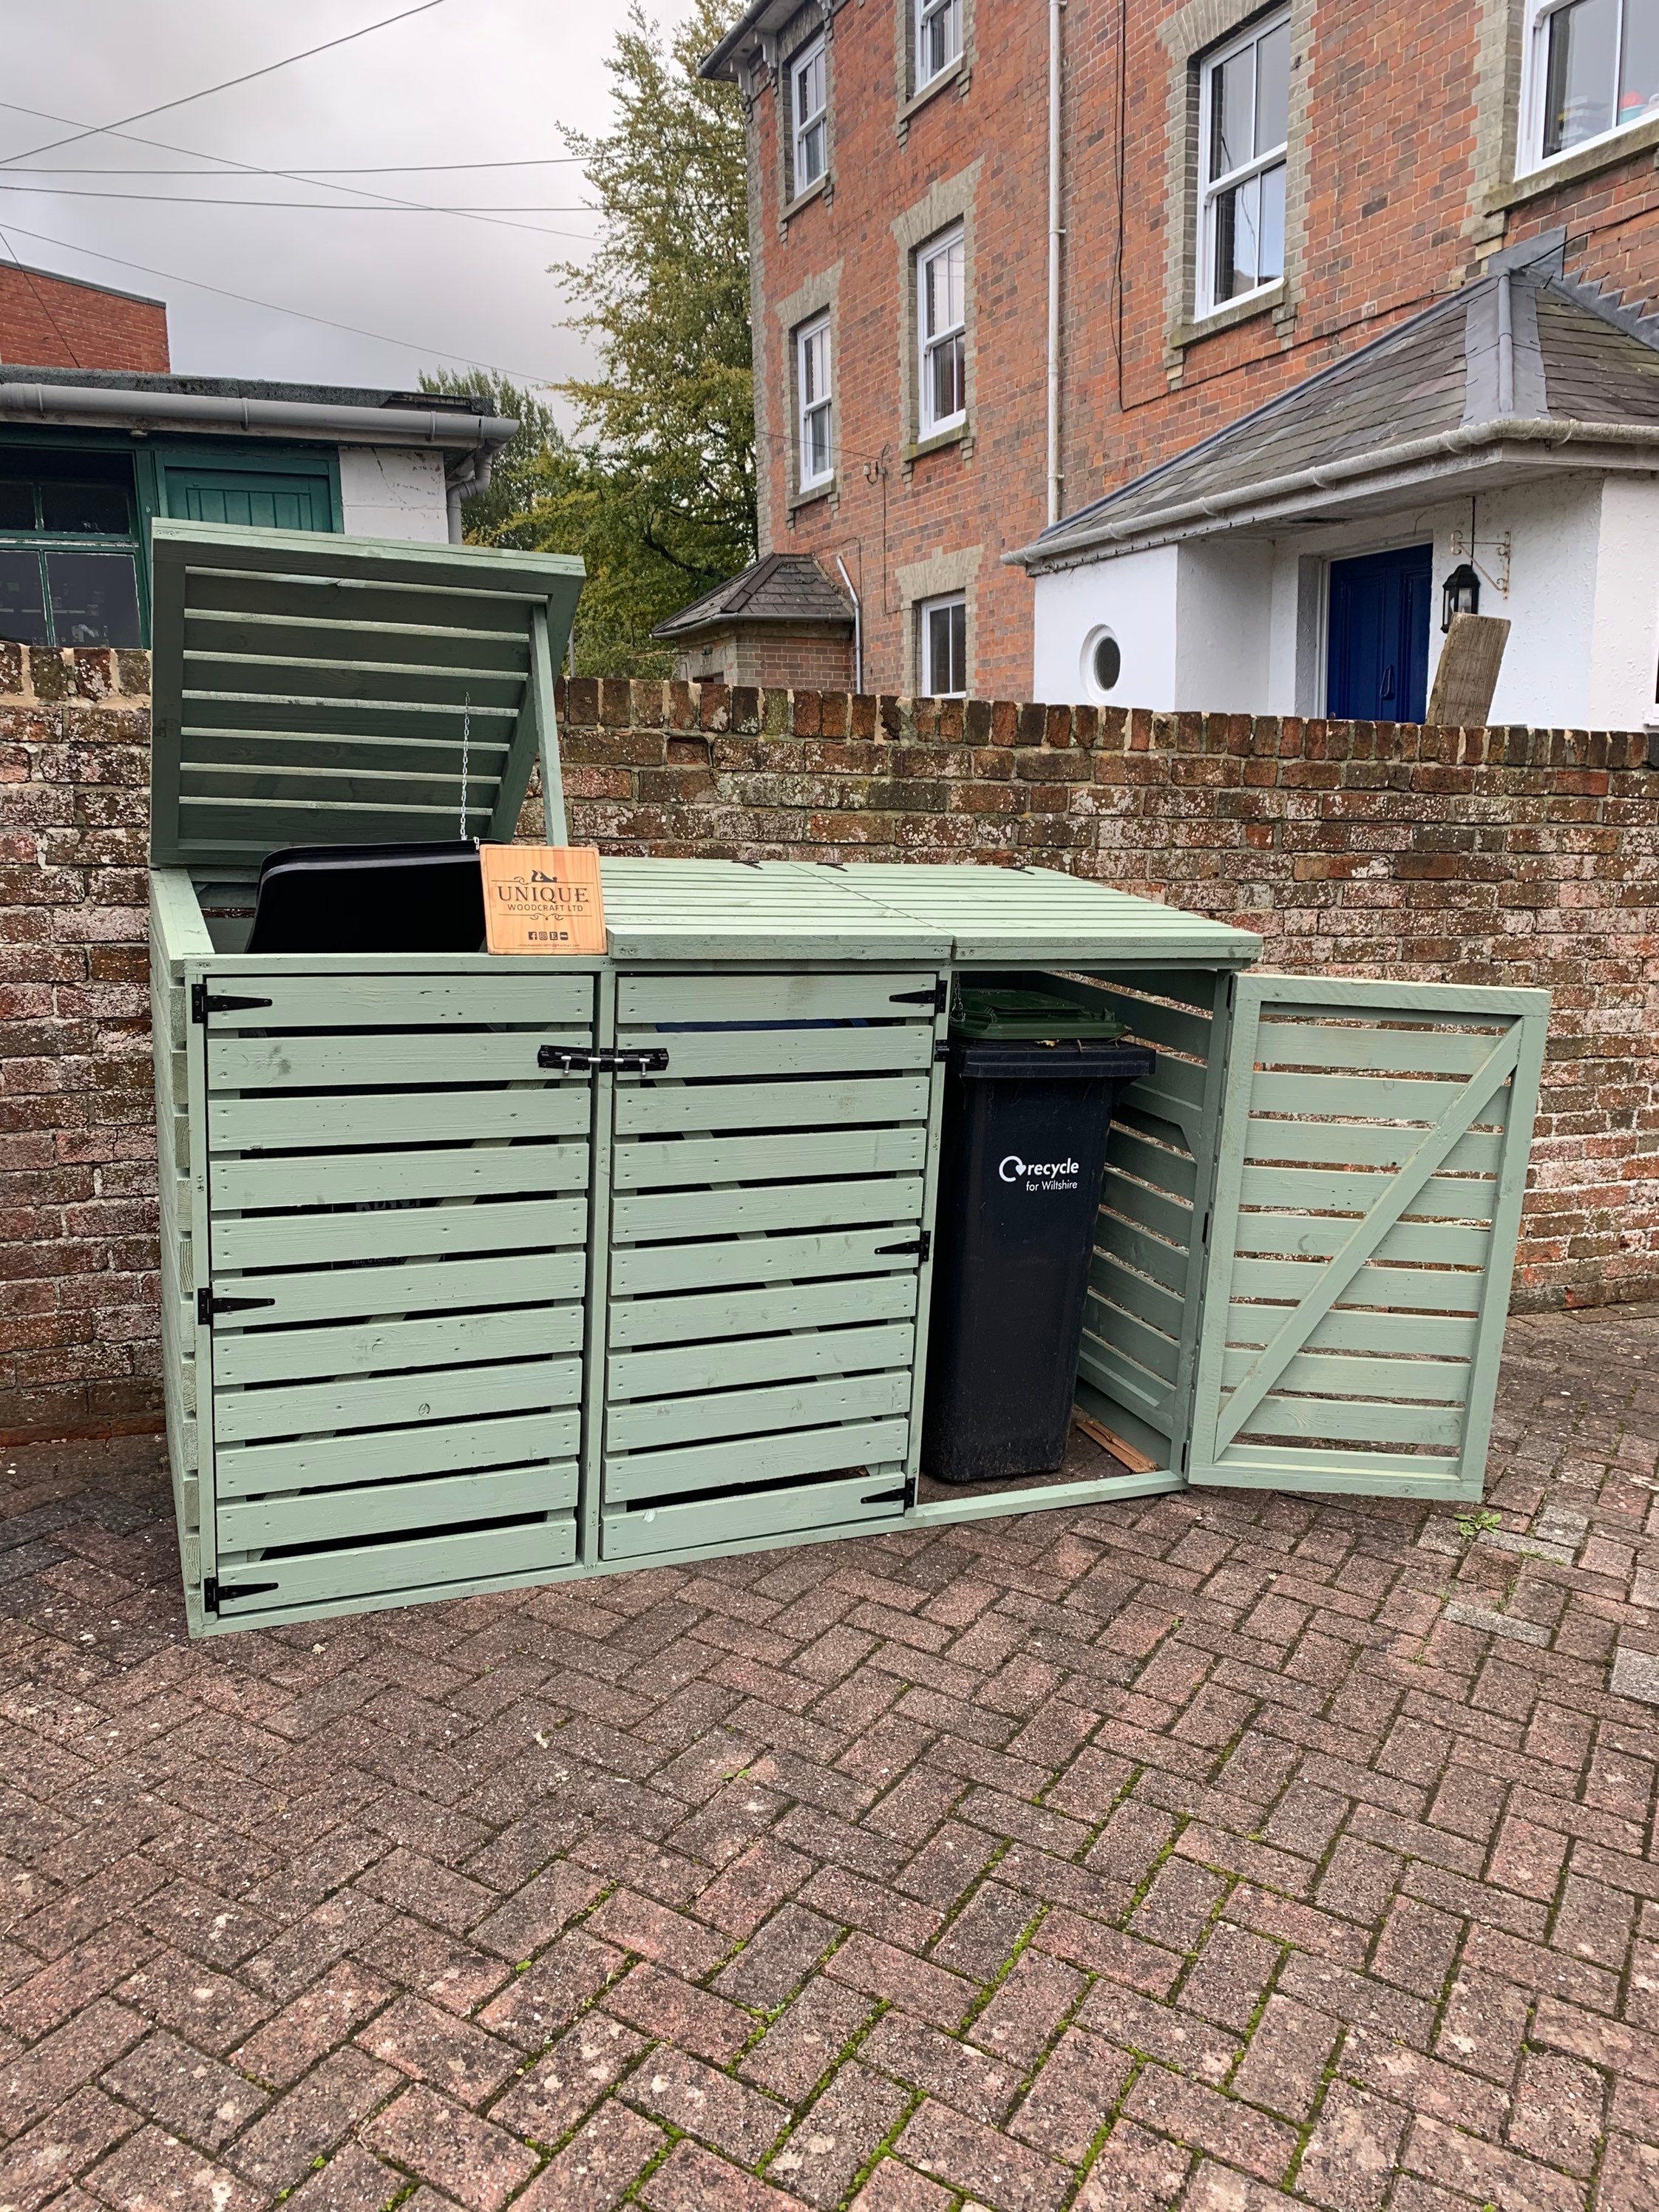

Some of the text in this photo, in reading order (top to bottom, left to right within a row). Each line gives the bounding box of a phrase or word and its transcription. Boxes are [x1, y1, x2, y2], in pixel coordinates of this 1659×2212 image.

[498, 886, 589, 904] UNIQUE
[507, 903, 564, 912] WOODCRAFT
[1027, 1158, 1079, 1178] recycle
[1026, 1179, 1078, 1191] for Wiltshire
